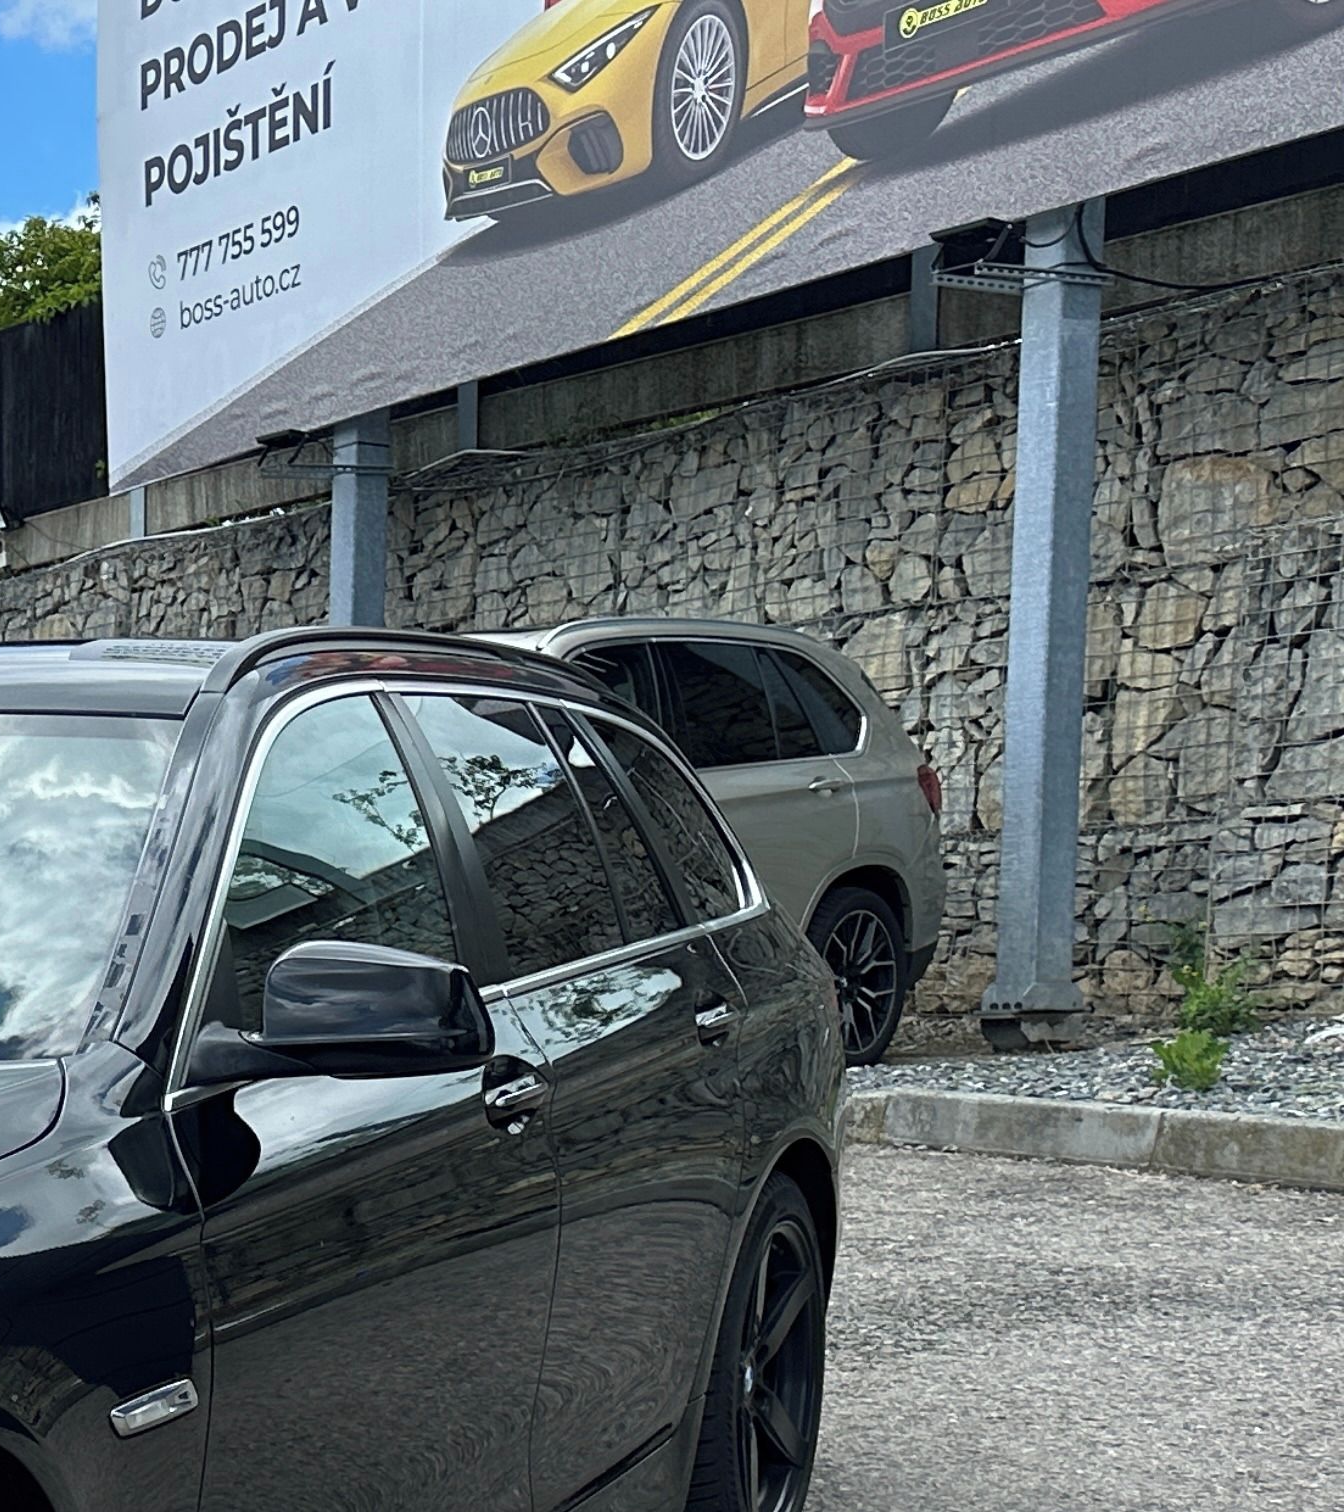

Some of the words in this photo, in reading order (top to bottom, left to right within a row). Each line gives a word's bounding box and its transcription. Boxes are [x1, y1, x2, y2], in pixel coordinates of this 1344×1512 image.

[140, 0, 286, 112] PRODEJ
[296, 0, 329, 36] A
[144, 59, 337, 208] POJIŠTĚNÍ
[176, 239, 213, 281] 777
[218, 222, 255, 265] 755
[260, 205, 300, 248] 599
[180, 263, 302, 330] boss-auto.cz
